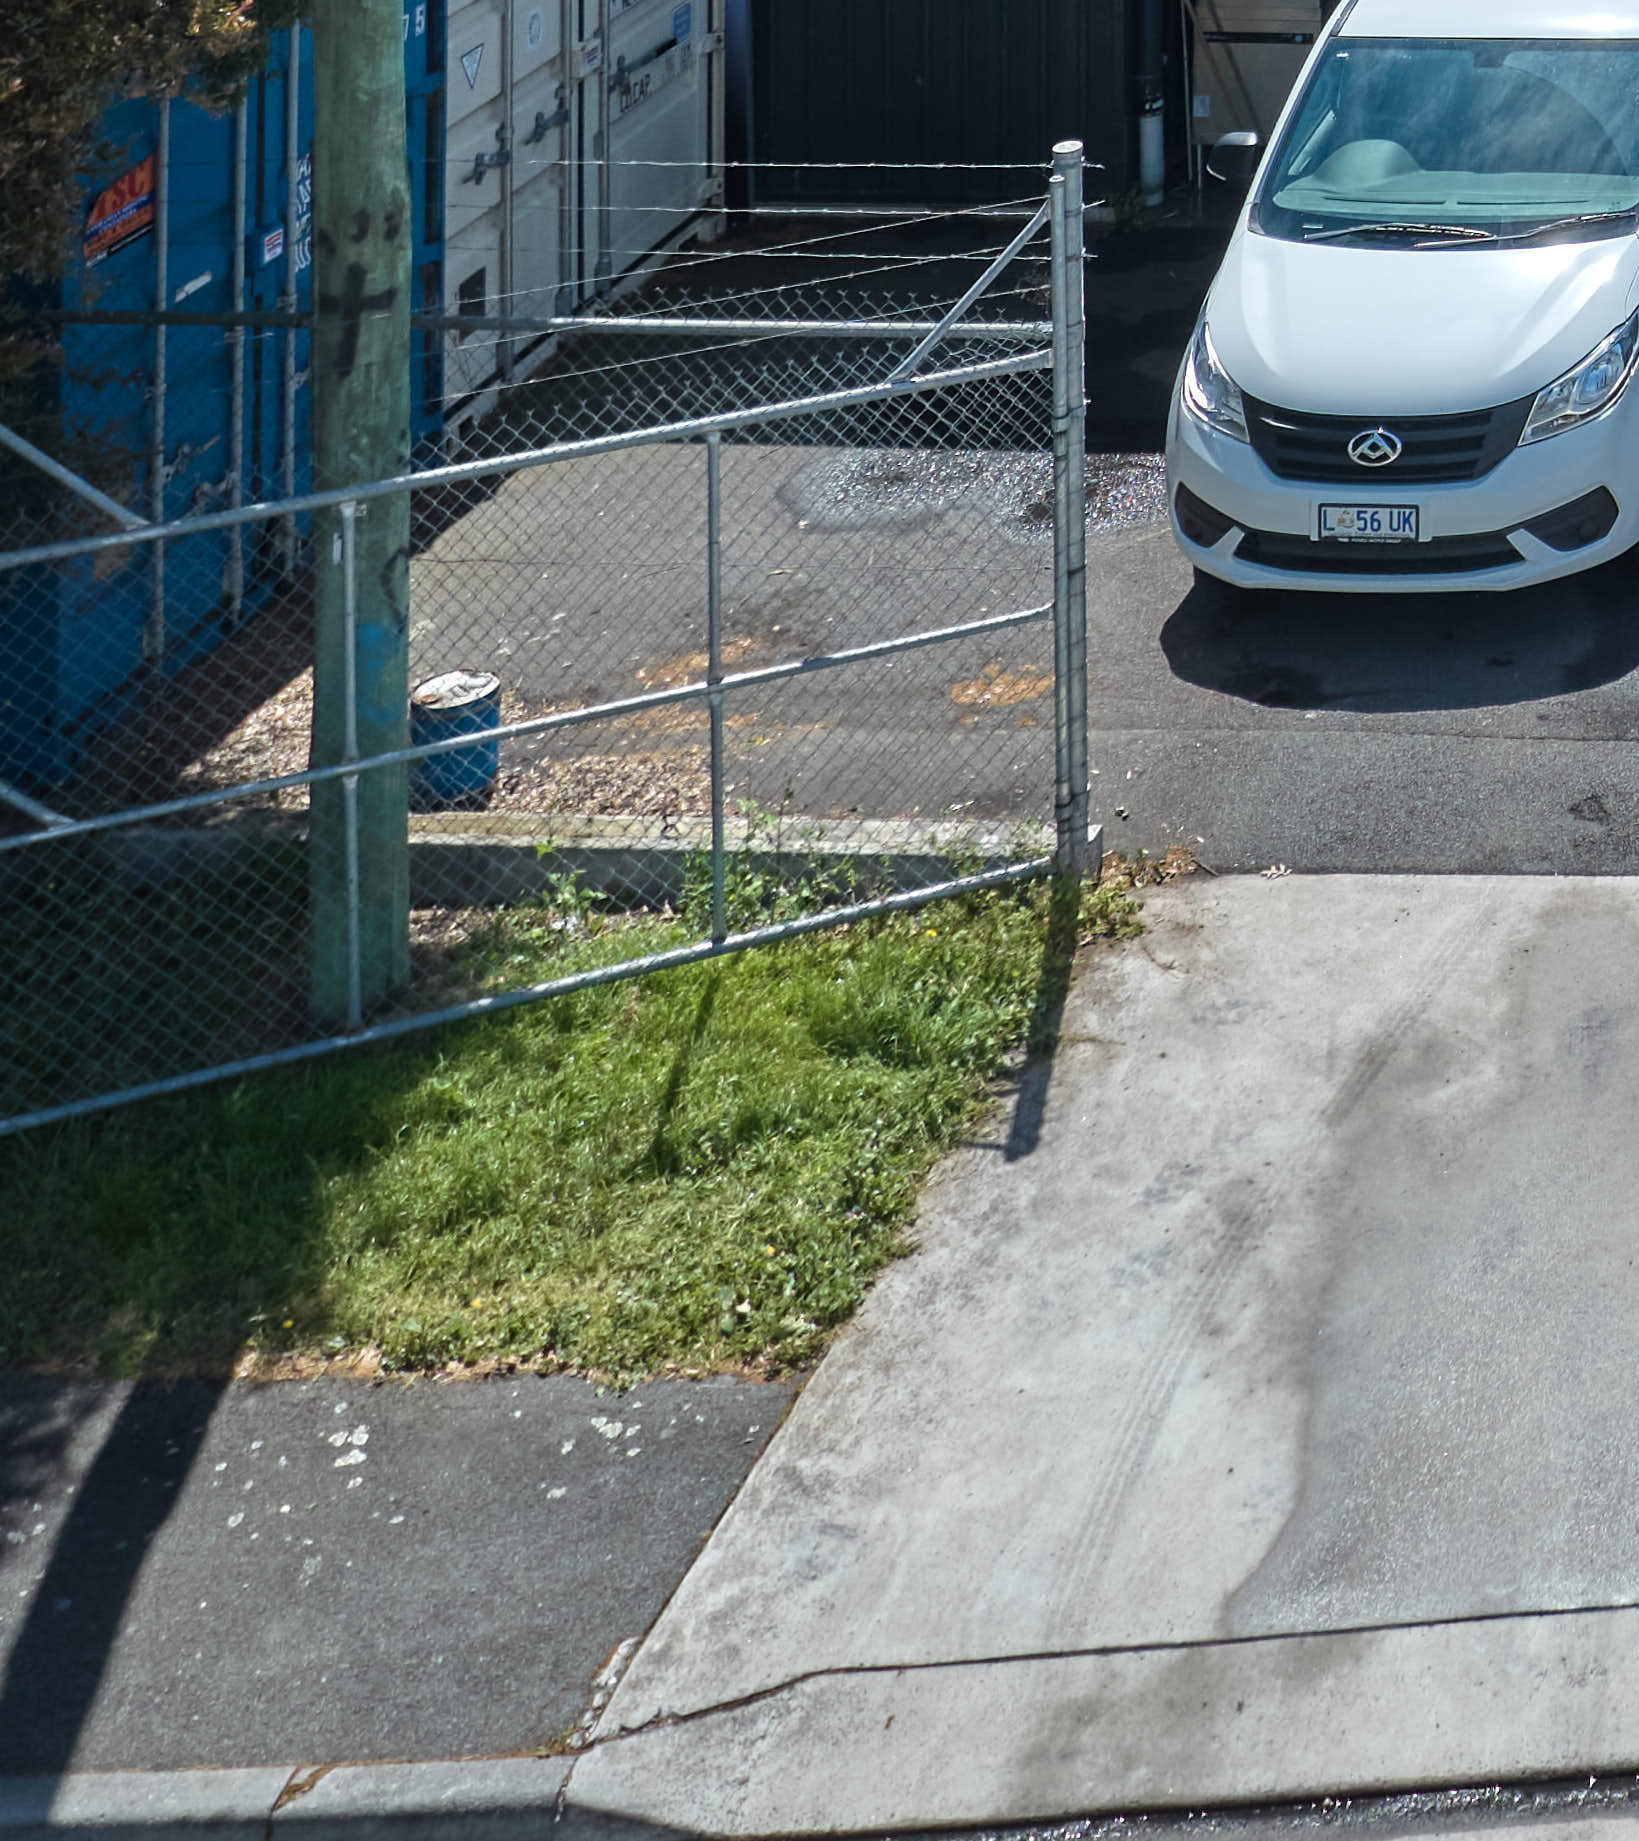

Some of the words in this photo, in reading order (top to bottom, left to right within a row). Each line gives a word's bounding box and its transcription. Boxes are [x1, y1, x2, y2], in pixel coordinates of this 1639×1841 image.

[1323, 509, 1335, 531] L
[1356, 510, 1381, 532] 56
[1389, 510, 1414, 532] UK
